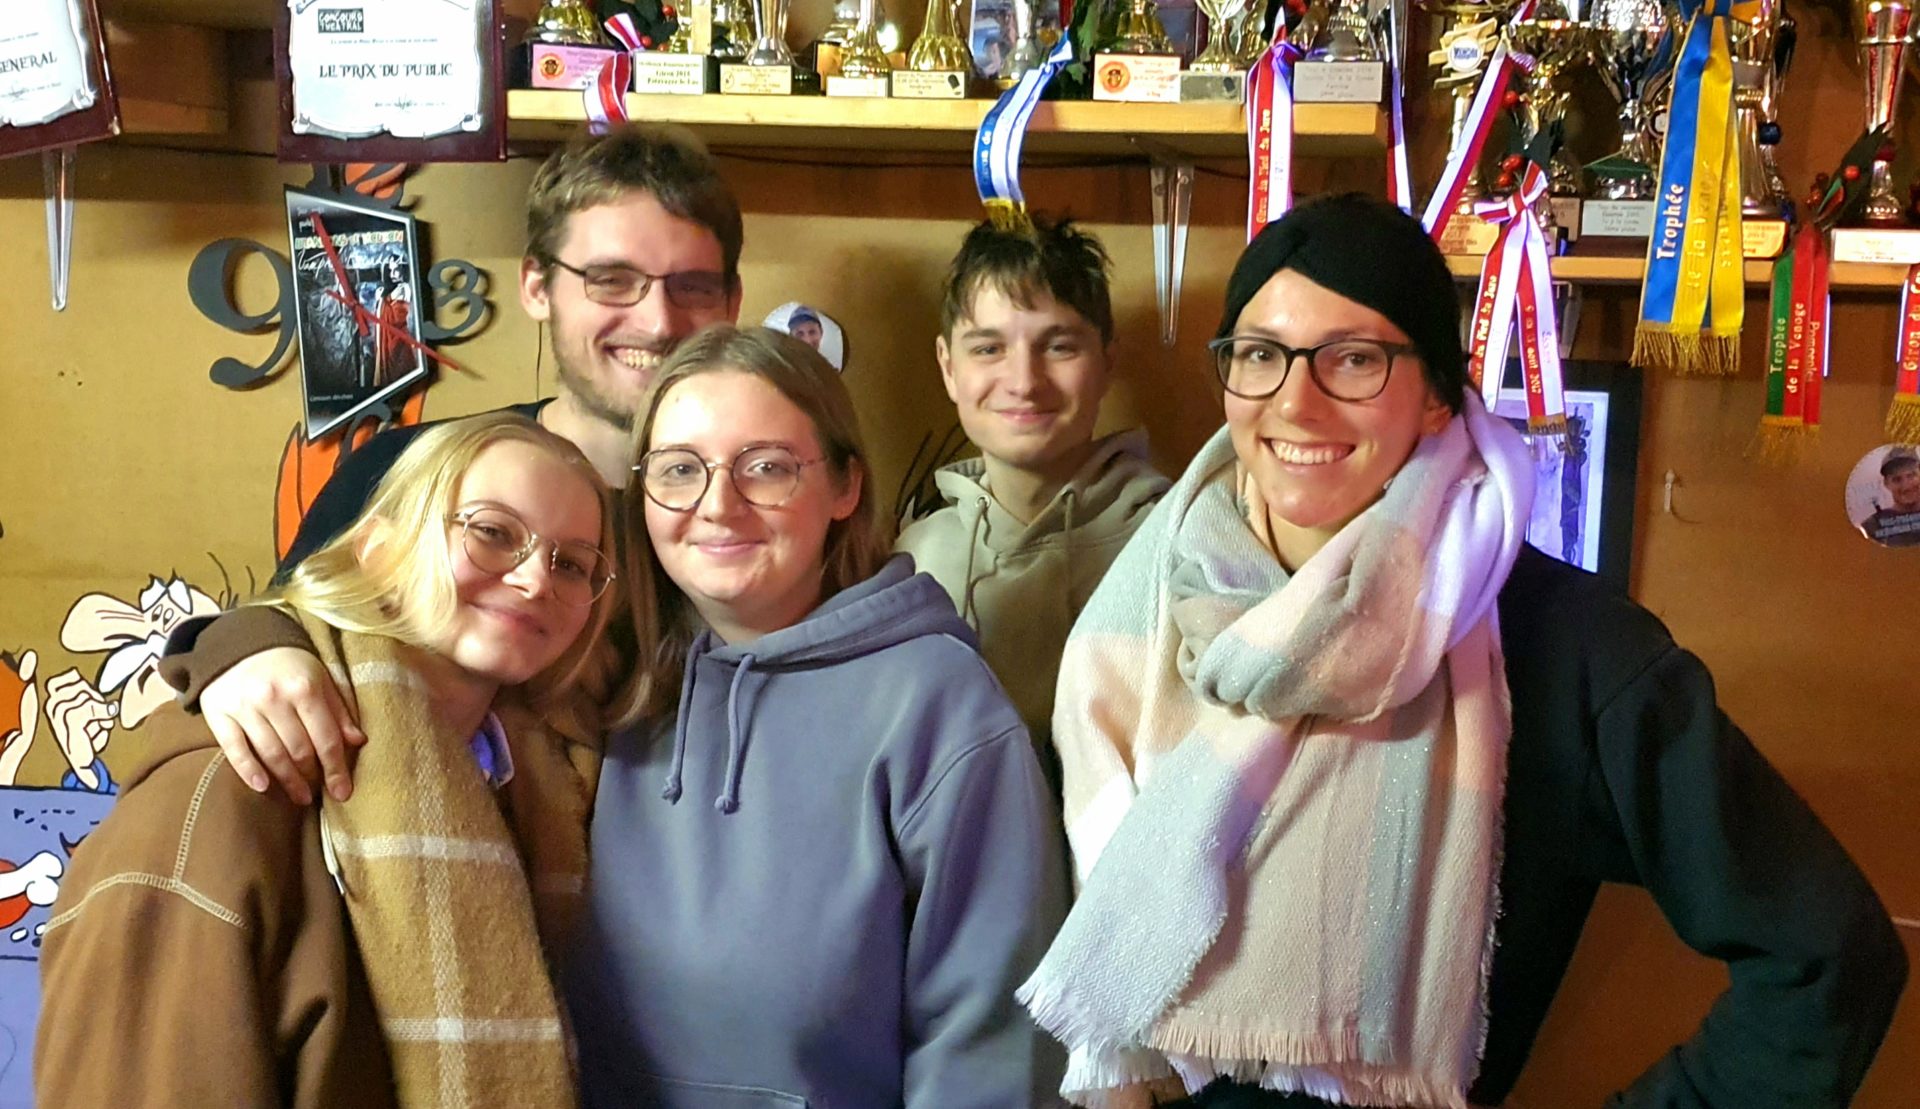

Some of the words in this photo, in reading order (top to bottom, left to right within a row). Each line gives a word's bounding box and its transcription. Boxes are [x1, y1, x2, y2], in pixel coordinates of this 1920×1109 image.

[0, 50, 58, 73] ENERAL
[319, 64, 338, 78] LE
[339, 63, 377, 80] PRIX
[379, 64, 399, 77] DU
[402, 63, 454, 77] PUBLIC
[1656, 184, 1685, 260] Trophée
[1788, 302, 1807, 350] Venoge
[1903, 330, 1920, 371] Giron
[1787, 358, 1800, 371] la
[1786, 377, 1799, 394] de
